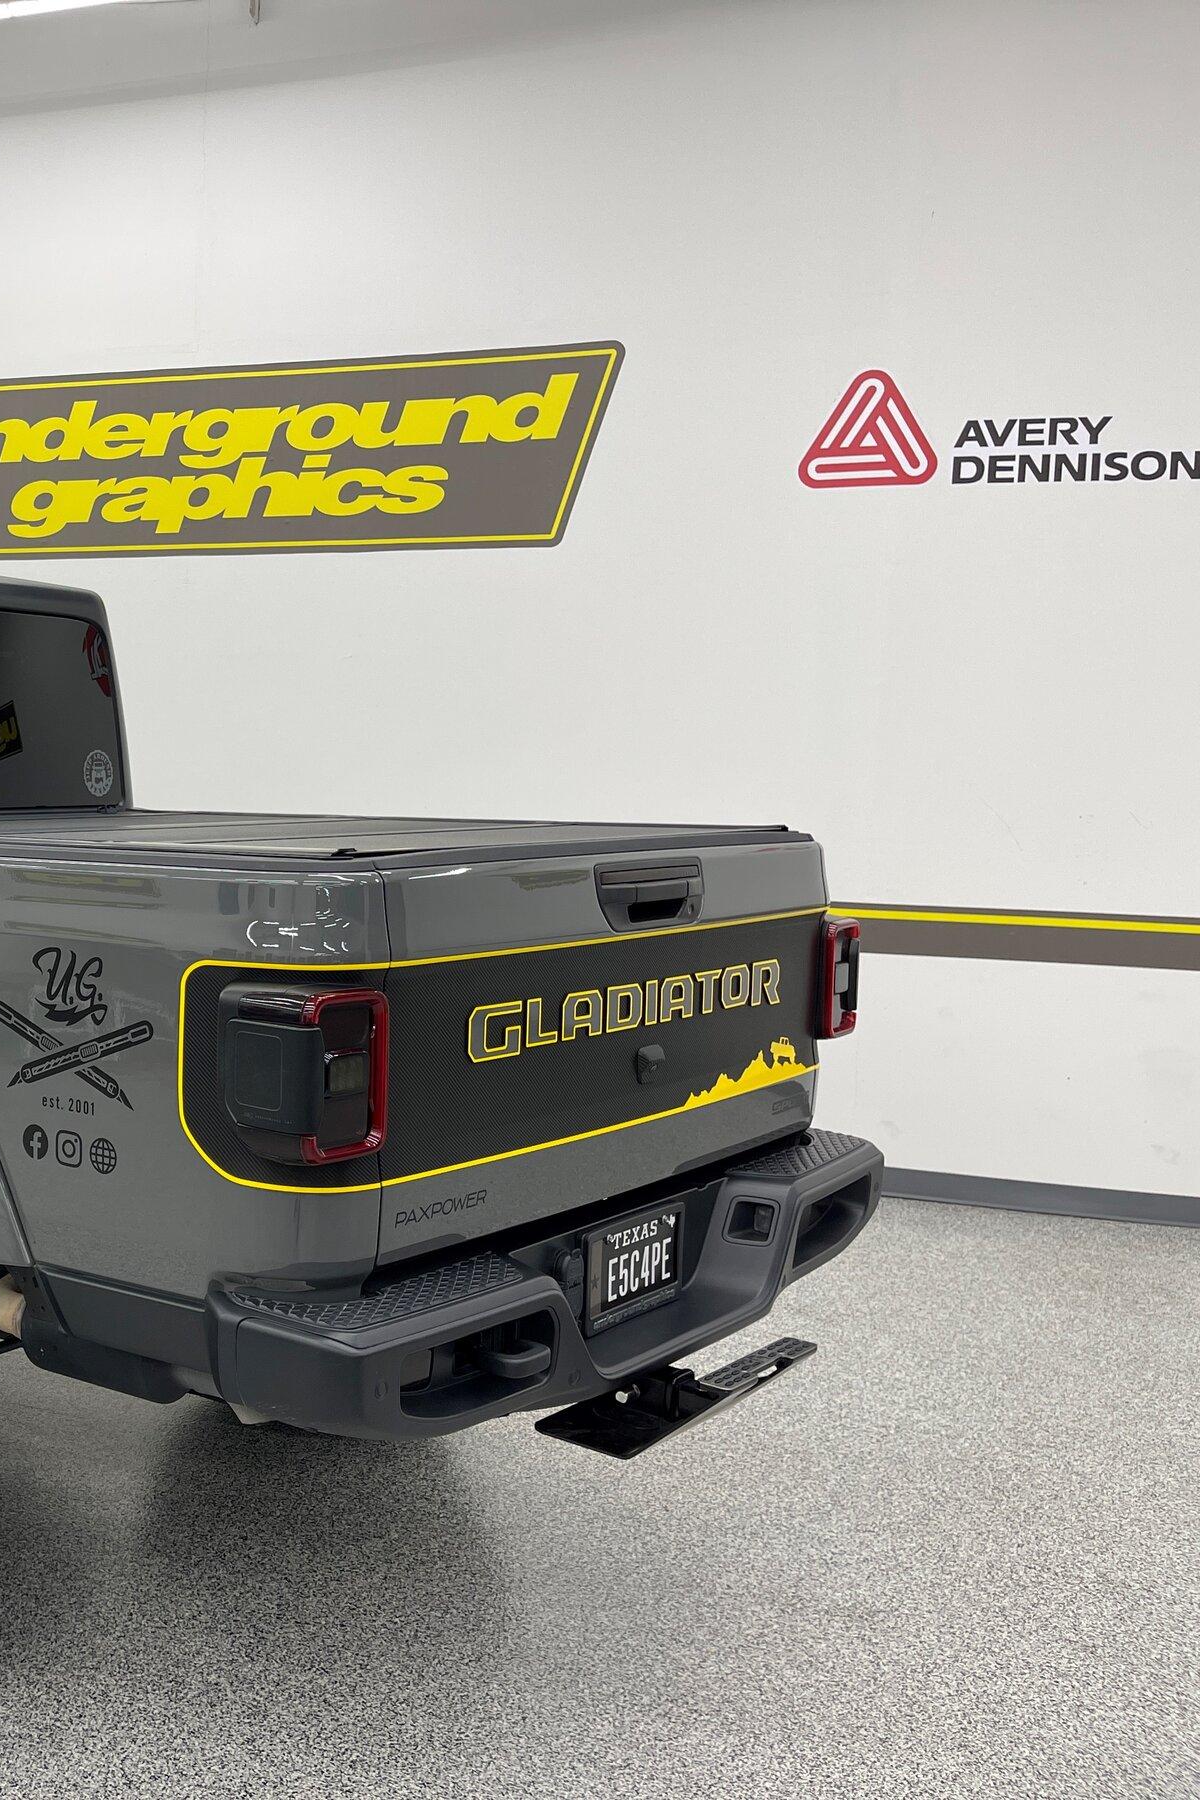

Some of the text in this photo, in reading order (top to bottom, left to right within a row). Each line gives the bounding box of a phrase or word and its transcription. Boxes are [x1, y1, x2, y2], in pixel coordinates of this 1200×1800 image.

[954, 416, 1113, 448] AVERY
[951, 451, 1200, 484] DENNISON
[8, 452, 446, 539] graphics
[467, 958, 781, 1063] GLADIATOR
[42, 1096, 95, 1116] est. 2001
[395, 1190, 488, 1228] PAXPOWER
[612, 1220, 658, 1250] TEXAS
[608, 1237, 672, 1303] E5C4PE
